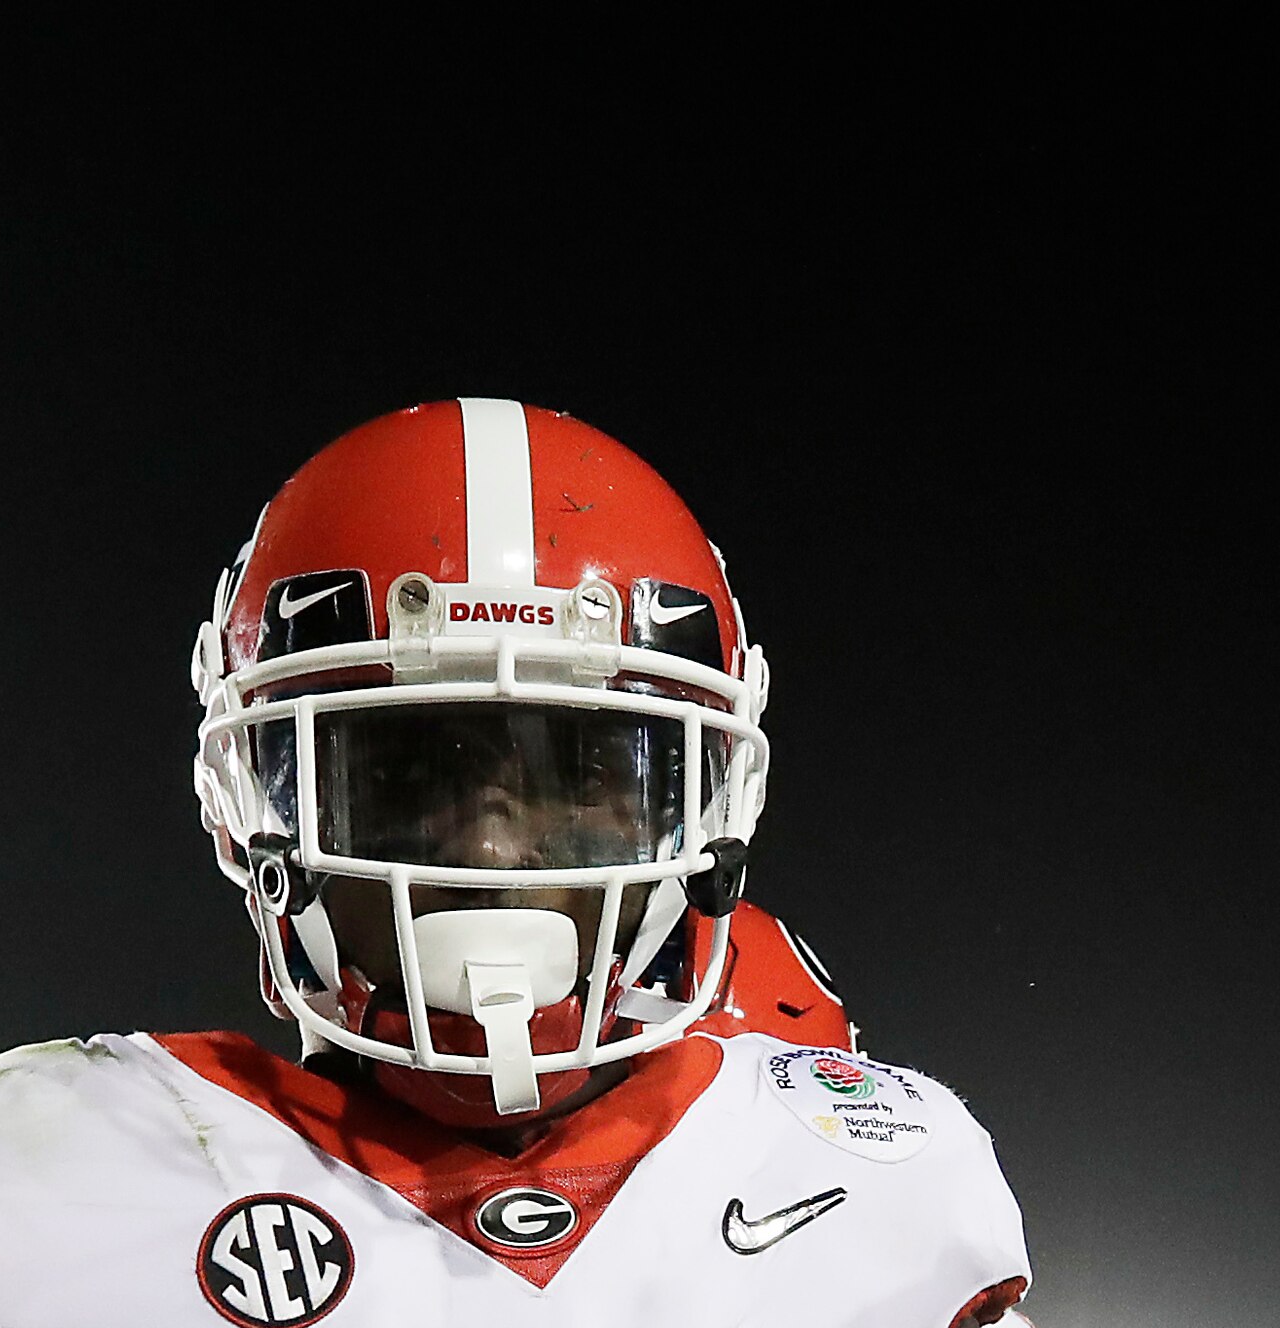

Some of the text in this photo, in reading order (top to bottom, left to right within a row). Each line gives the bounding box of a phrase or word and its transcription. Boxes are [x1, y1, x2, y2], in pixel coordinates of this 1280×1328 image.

[449, 602, 554, 626] DAWGS
[769, 1054, 797, 1091] ROSE
[881, 1102, 894, 1115] by
[843, 1116, 929, 1134] Northwestern
[848, 1128, 896, 1143] Mutual
[478, 1189, 575, 1246] G
[210, 1203, 343, 1323] SEC
